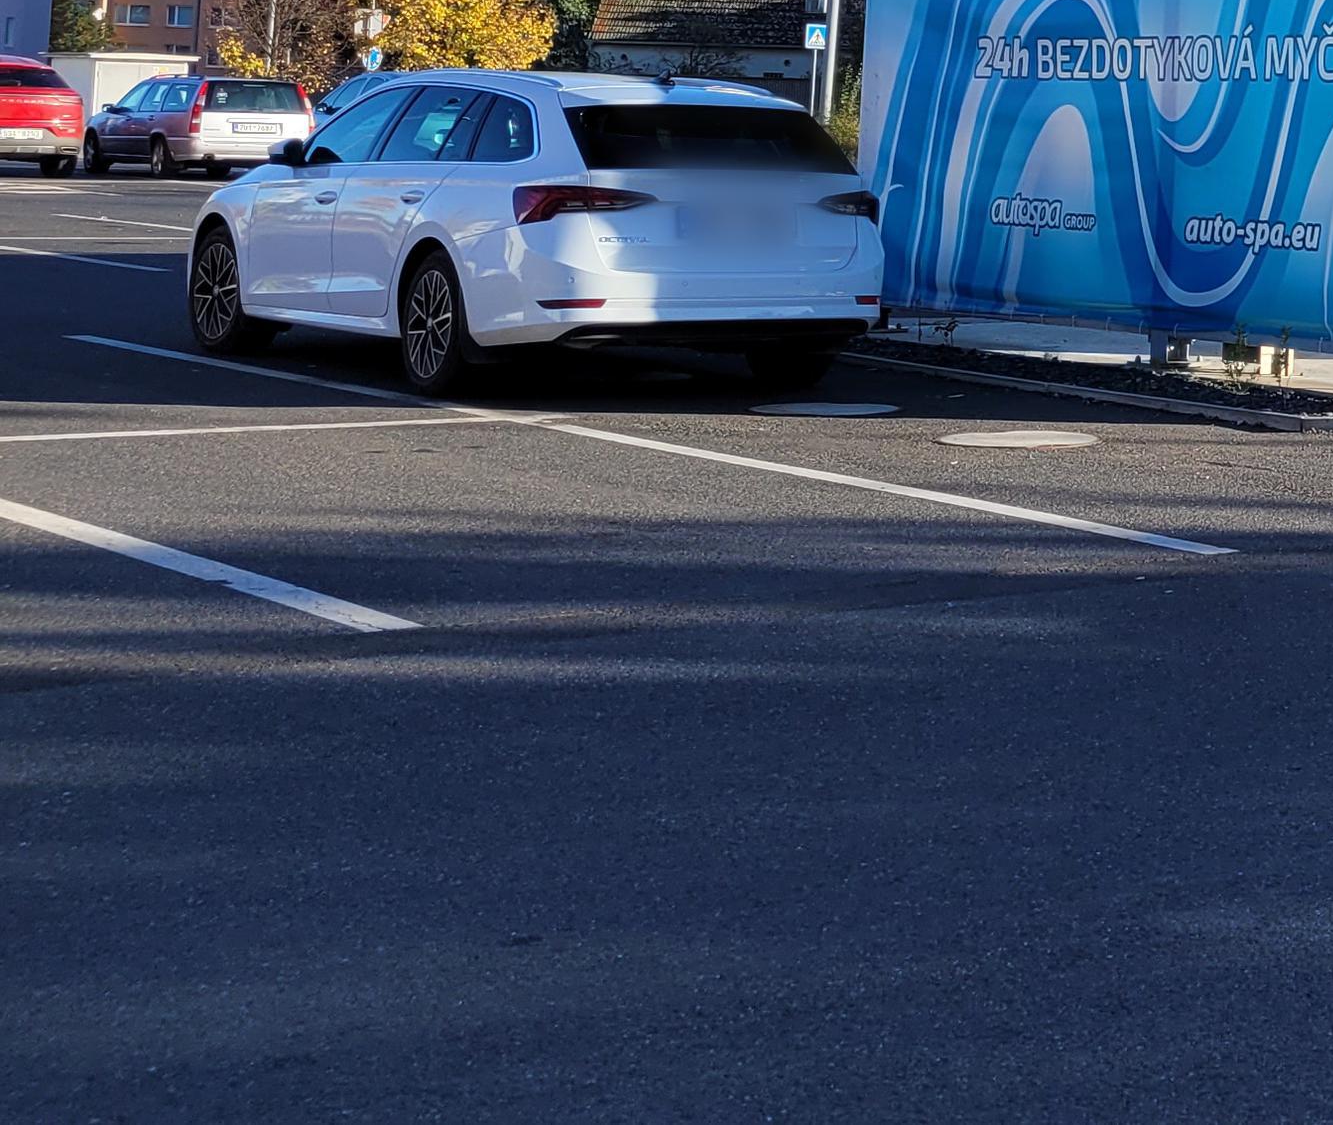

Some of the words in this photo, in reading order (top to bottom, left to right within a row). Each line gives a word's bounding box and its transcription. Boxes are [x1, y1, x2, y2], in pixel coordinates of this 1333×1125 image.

[975, 37, 1030, 77] 24h
[1037, 24, 1257, 81] BEZDOTYKOVÁ
[991, 196, 1062, 235] autospa
[1065, 215, 1096, 230] GROUP
[1185, 216, 1321, 253] auto-spa.eu
